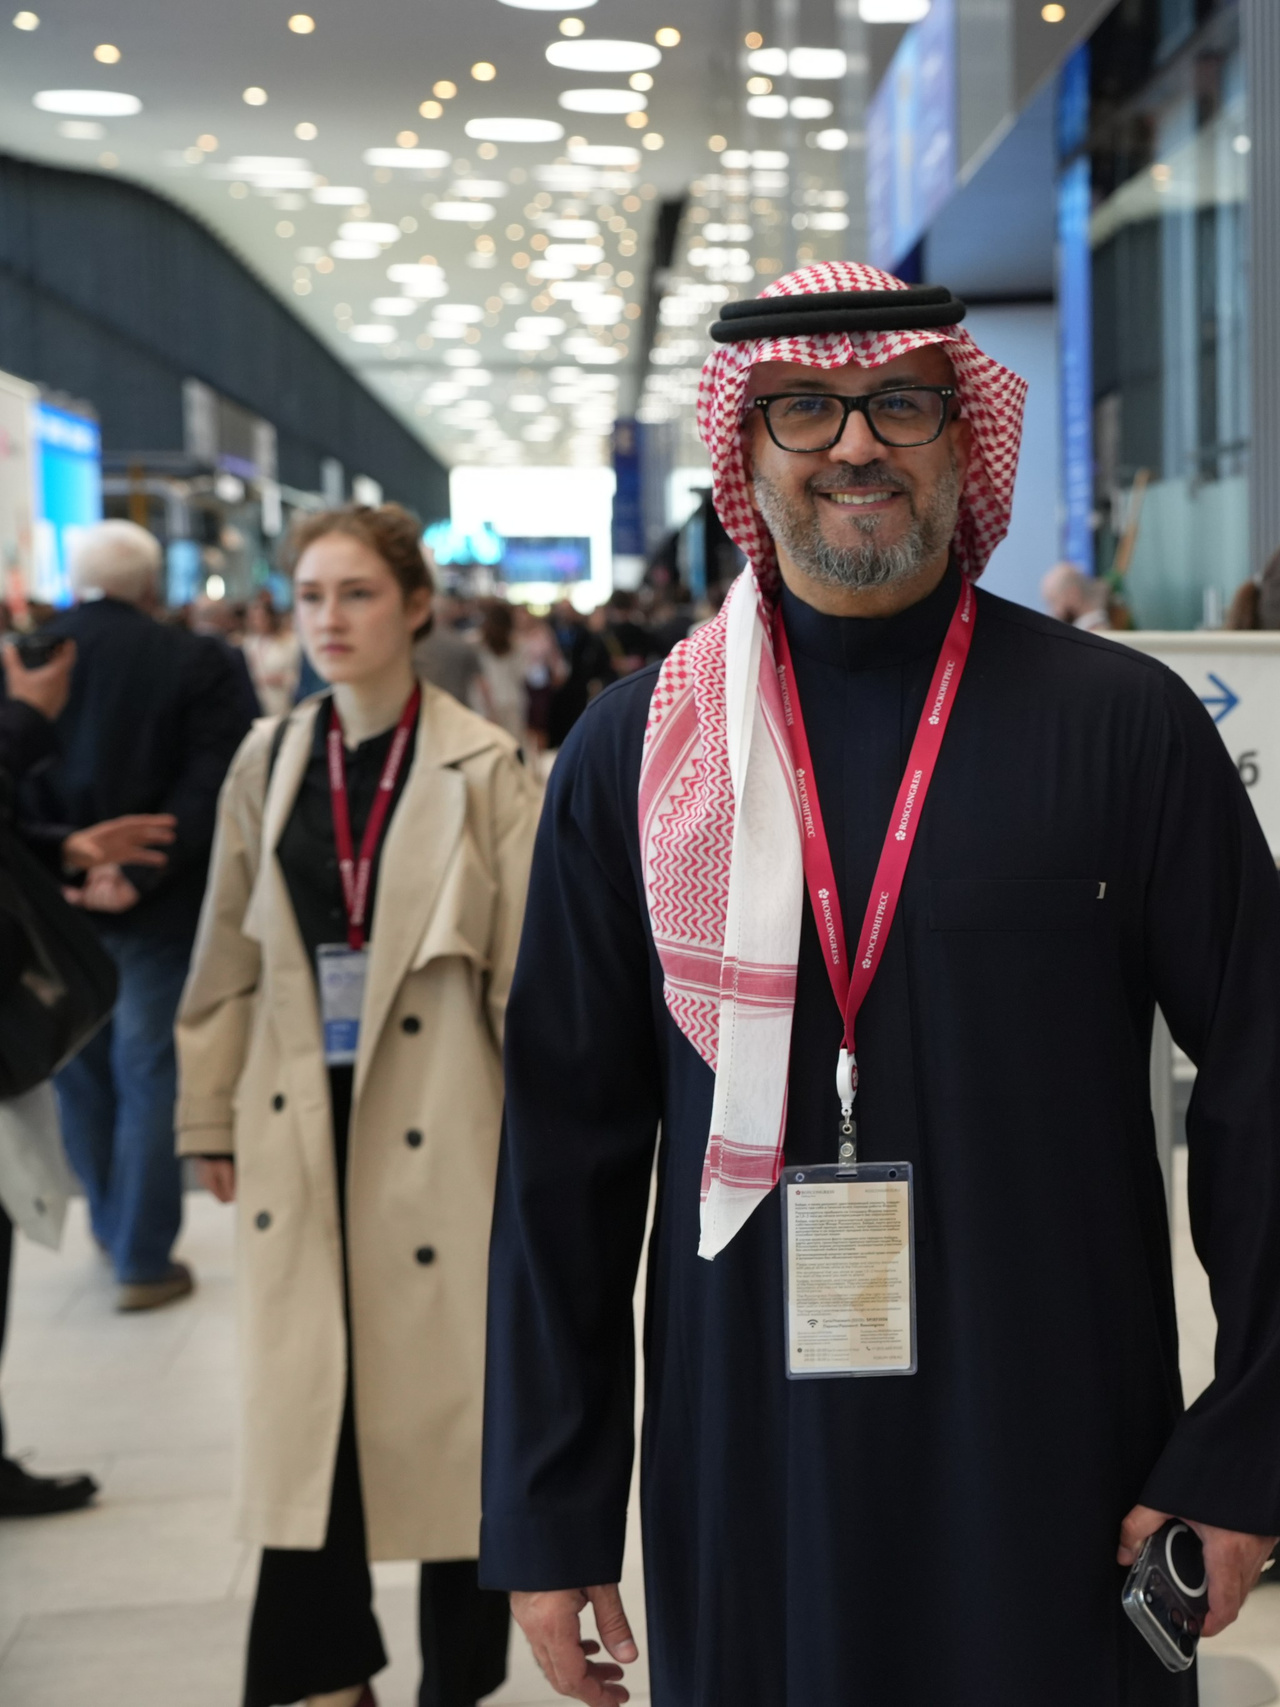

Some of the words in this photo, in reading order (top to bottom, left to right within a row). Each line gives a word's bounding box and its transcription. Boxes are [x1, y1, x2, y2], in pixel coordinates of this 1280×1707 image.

[779, 673, 794, 727] ROSCONGRESS
[932, 660, 955, 716] РОСКОНГРЕСС
[798, 778, 816, 838] РОСКОНГРЕСС
[898, 769, 923, 831] ROSCONGRESS
[821, 899, 840, 965] ROSCONGRESS
[866, 891, 890, 959] РОСКОНГРЕСС
